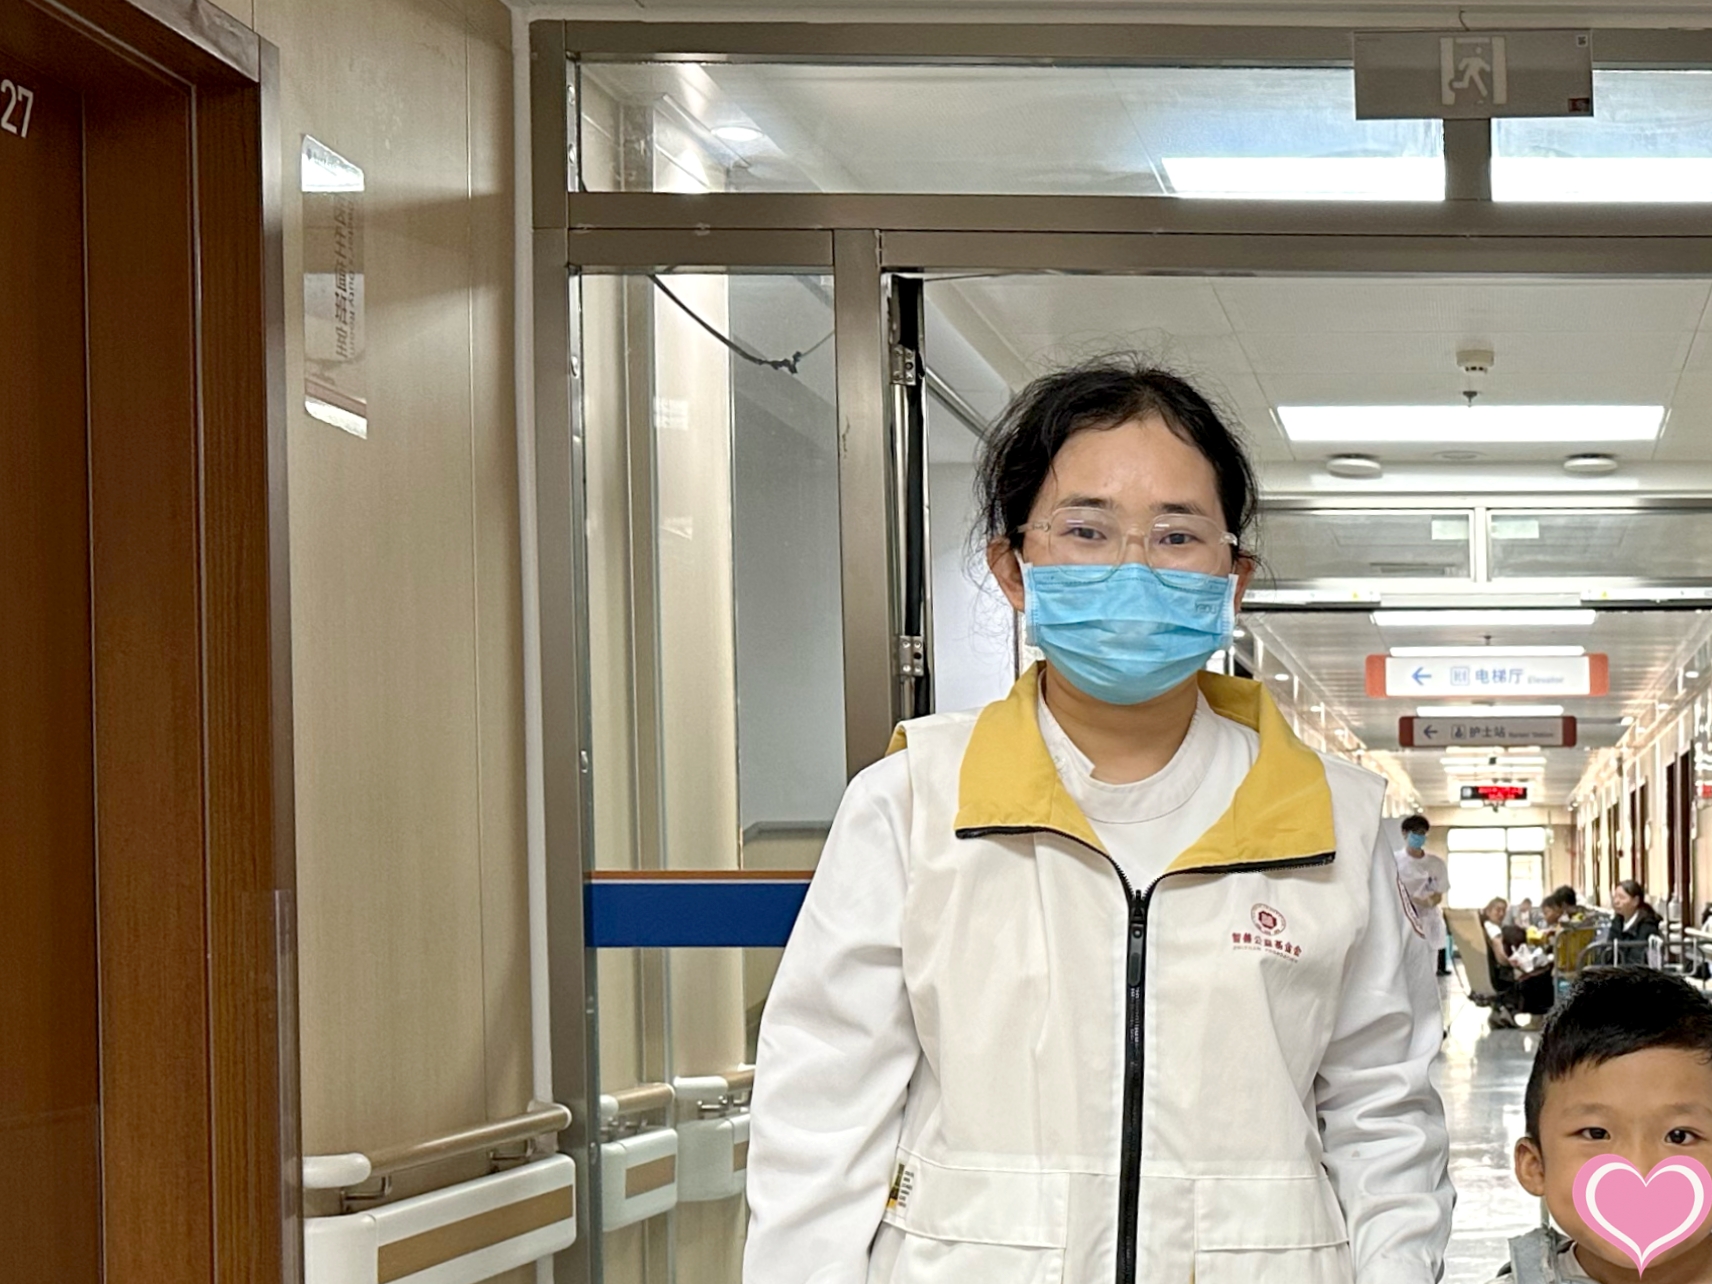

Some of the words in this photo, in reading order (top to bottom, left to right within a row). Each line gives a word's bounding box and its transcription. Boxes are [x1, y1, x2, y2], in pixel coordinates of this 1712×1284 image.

[1475, 668, 1523, 685] 电梯厅
[1469, 725, 1506, 738] 护士站
